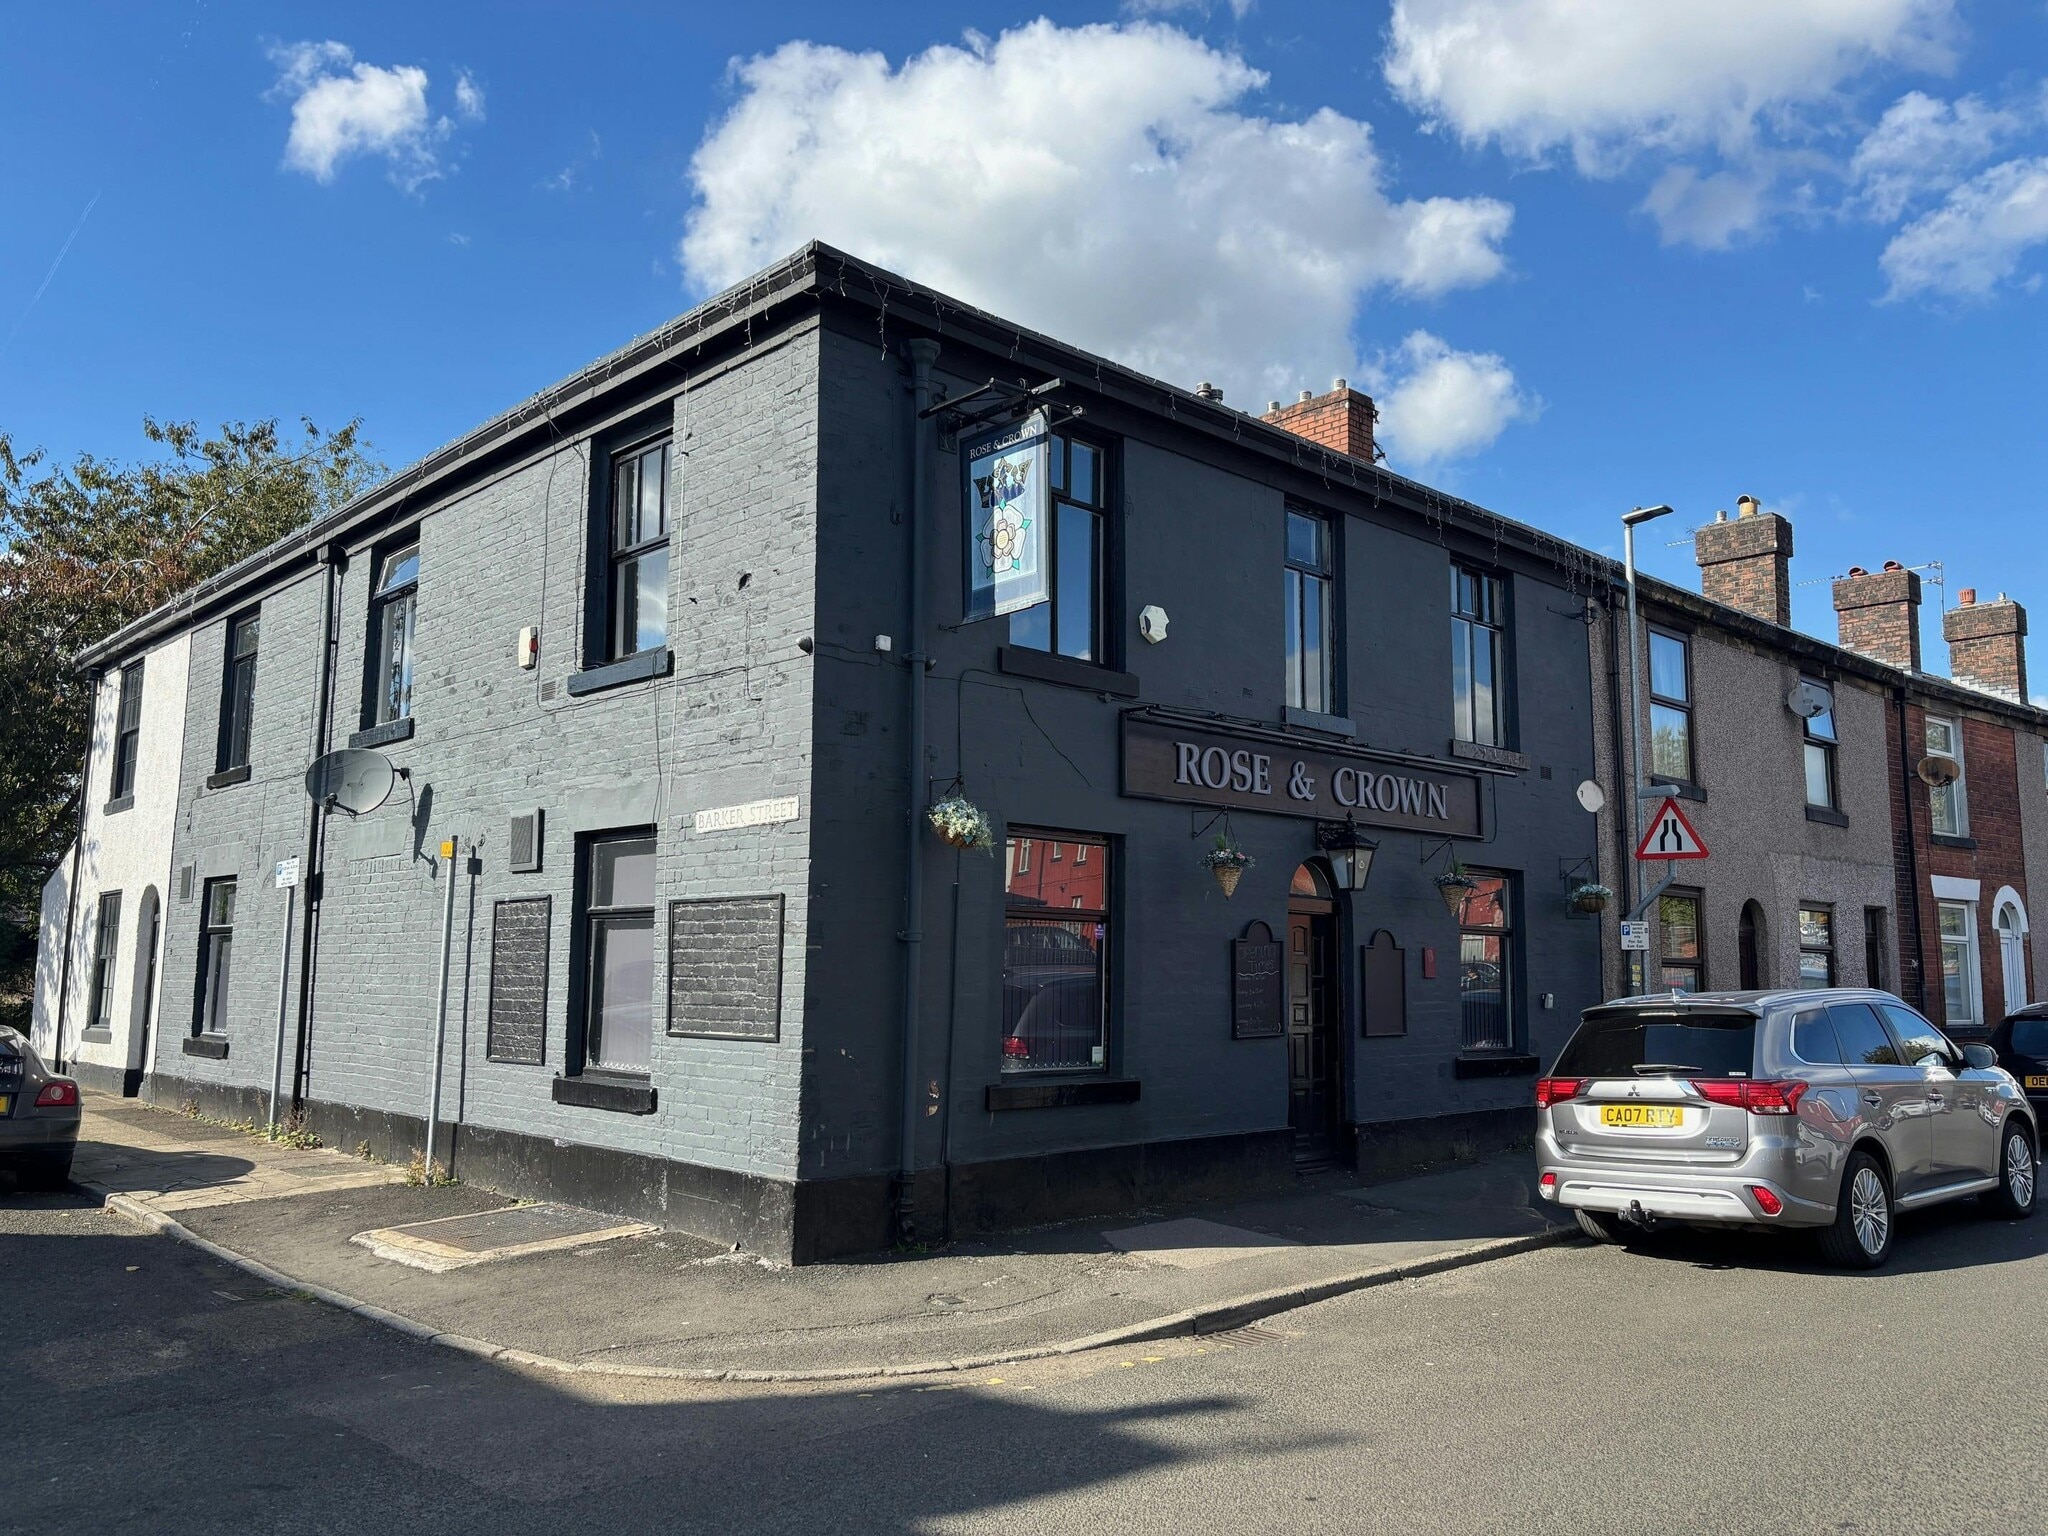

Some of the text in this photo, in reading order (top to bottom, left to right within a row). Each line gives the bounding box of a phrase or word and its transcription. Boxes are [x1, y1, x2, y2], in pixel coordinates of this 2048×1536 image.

[970, 424, 1037, 459] ROSE & CROWN
[1174, 741, 1449, 820] ROSE & CROWN
[698, 801, 796, 828] BARKER STREET
[2031, 1077, 2048, 1086] OE
[1605, 1108, 1675, 1124] CA07 RTY
